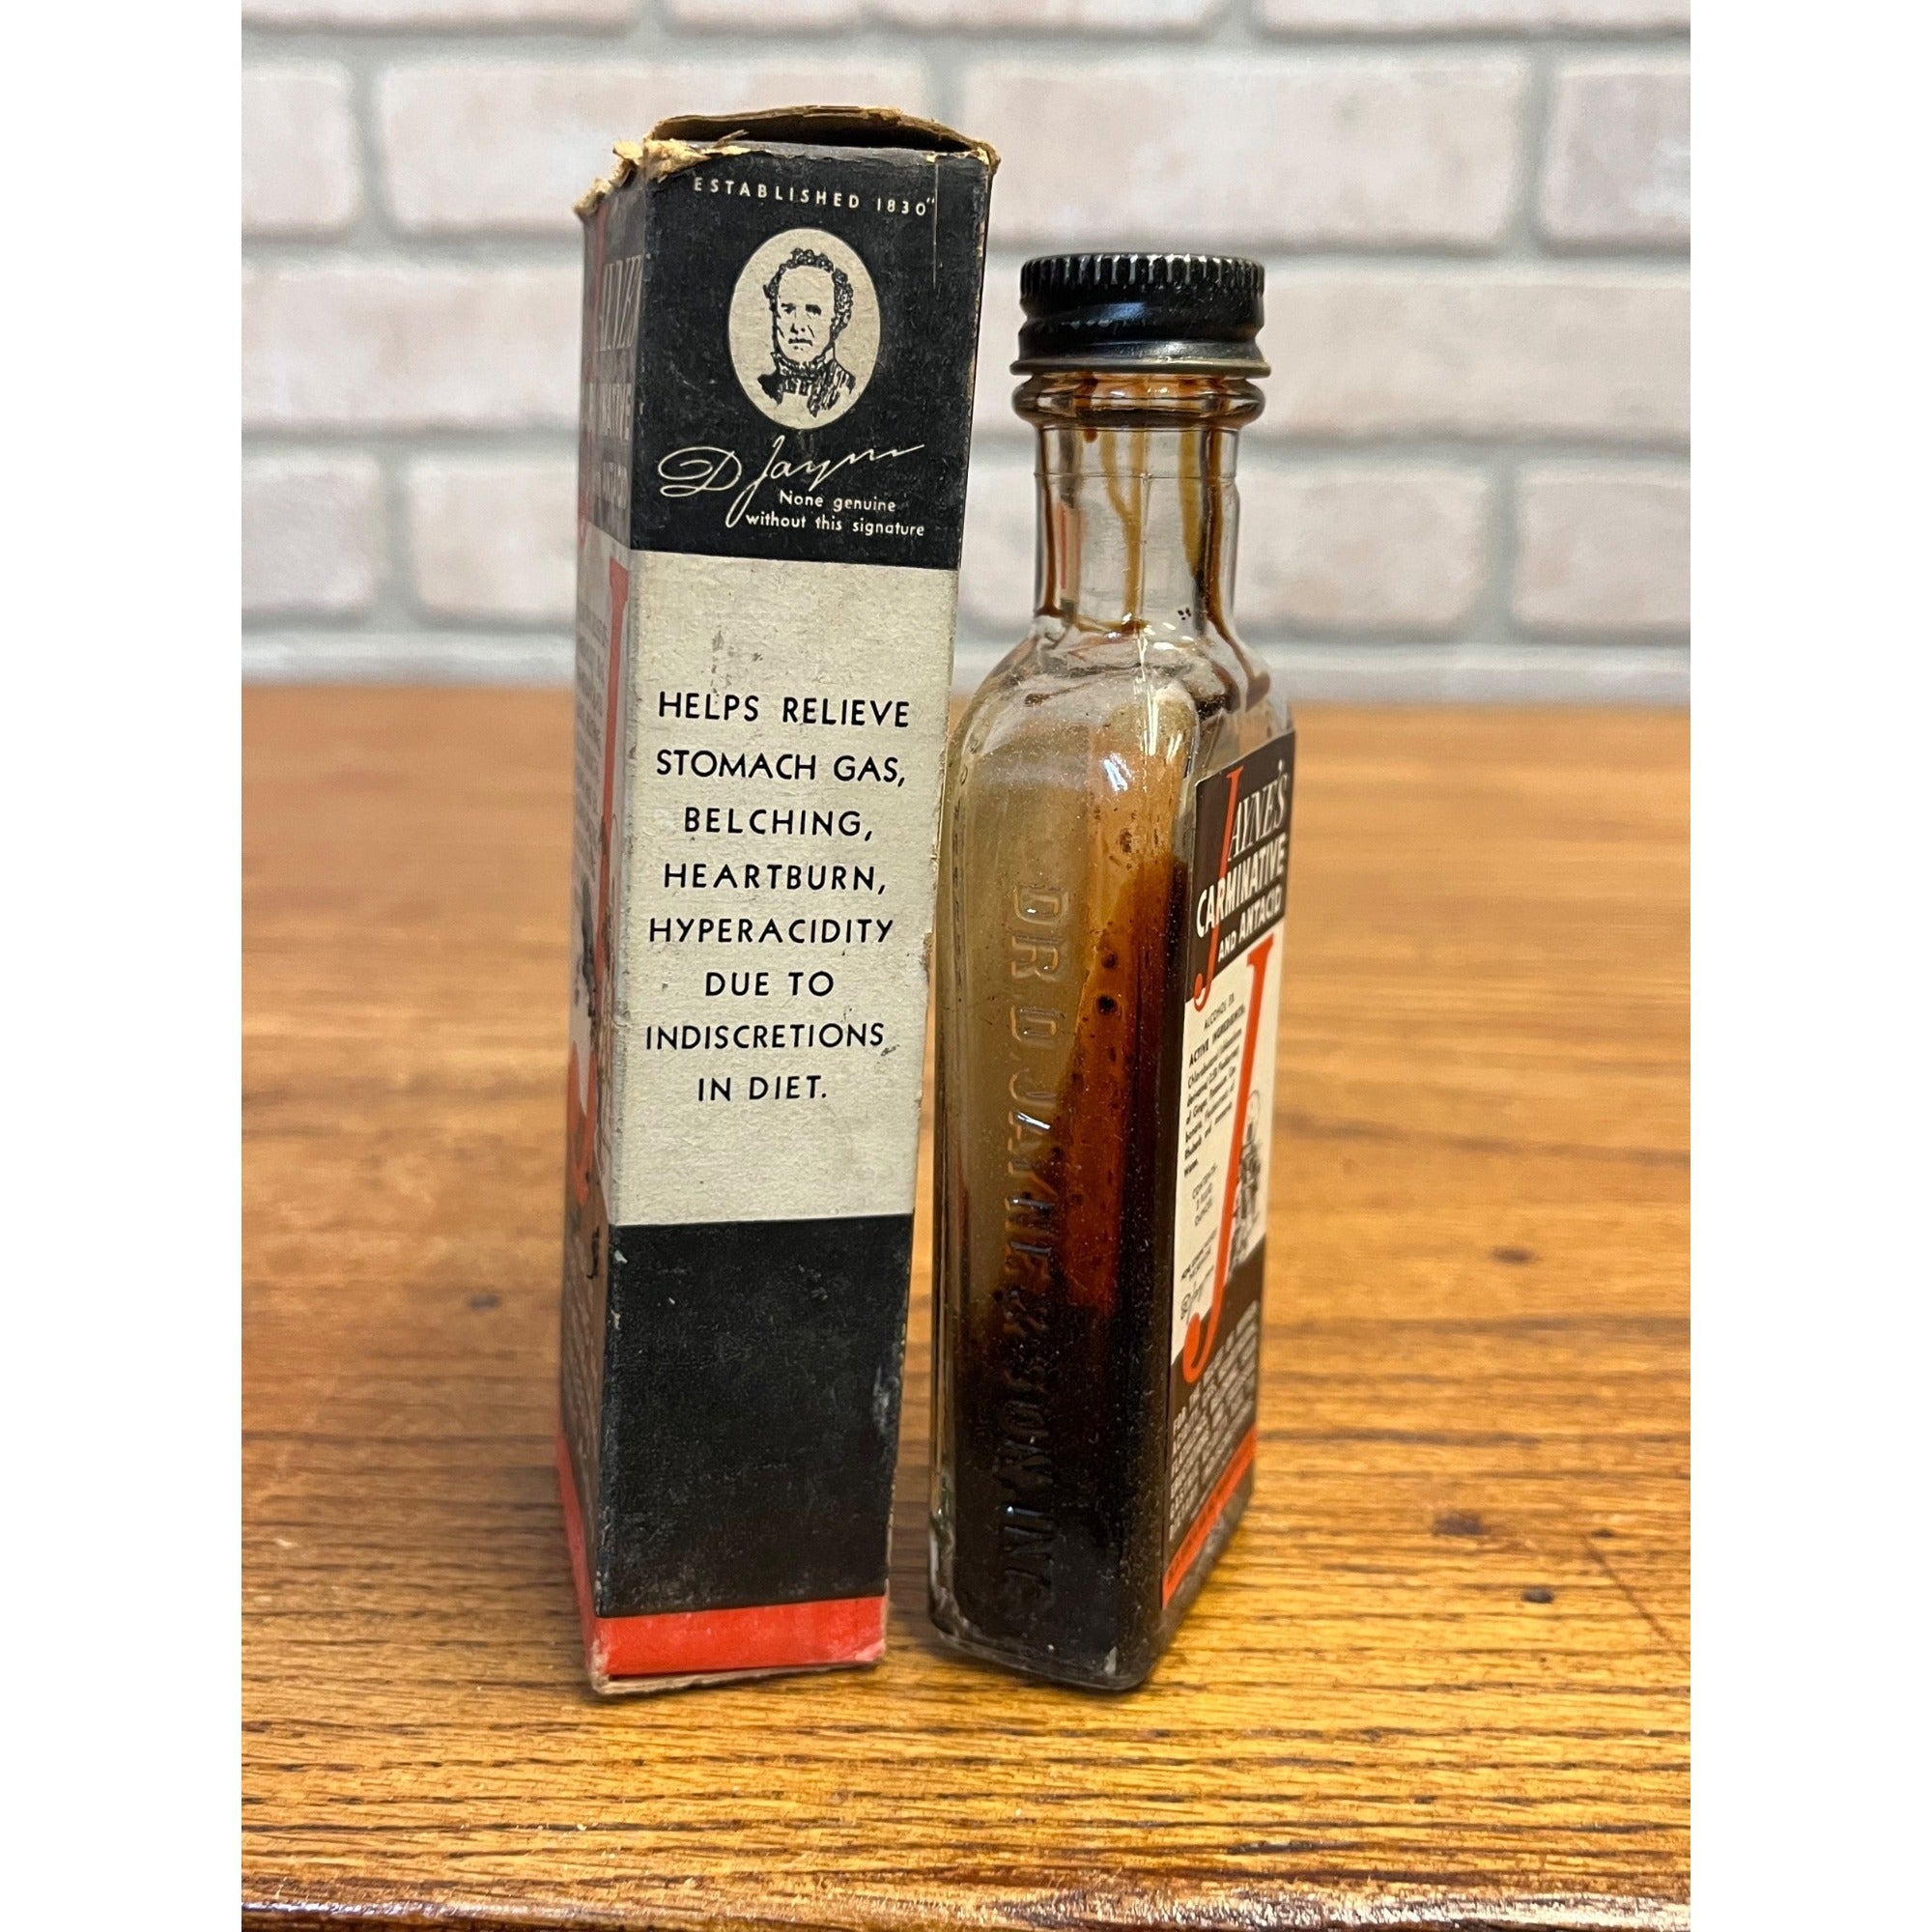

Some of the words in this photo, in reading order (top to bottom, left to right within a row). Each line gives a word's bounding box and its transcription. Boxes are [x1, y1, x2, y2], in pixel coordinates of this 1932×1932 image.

[694, 176, 860, 209] ESTABLISHED
[779, 490, 824, 508] None
[833, 496, 896, 513] genuine
[745, 510, 807, 529] without
[814, 512, 843, 531] this
[852, 518, 925, 537] signature
[659, 691, 759, 722] HELPS
[781, 696, 910, 728] RELIEVE
[656, 749, 816, 781] STOMACH
[834, 754, 906, 787] GAS,
[685, 807, 873, 841] BELCHING,
[664, 863, 887, 895] HEARTBURN,
[1196, 831, 1287, 939] CARMINATIVE
[649, 918, 895, 944] HYPERACIDITY
[1217, 929, 1237, 963] AND
[1237, 881, 1283, 944] ANTACID
[704, 971, 770, 997] DUE
[788, 971, 835, 997] TO
[646, 1022, 884, 1050] INDISCRETIONS
[698, 1077, 731, 1102] IN
[749, 1075, 828, 1101] DIET.
